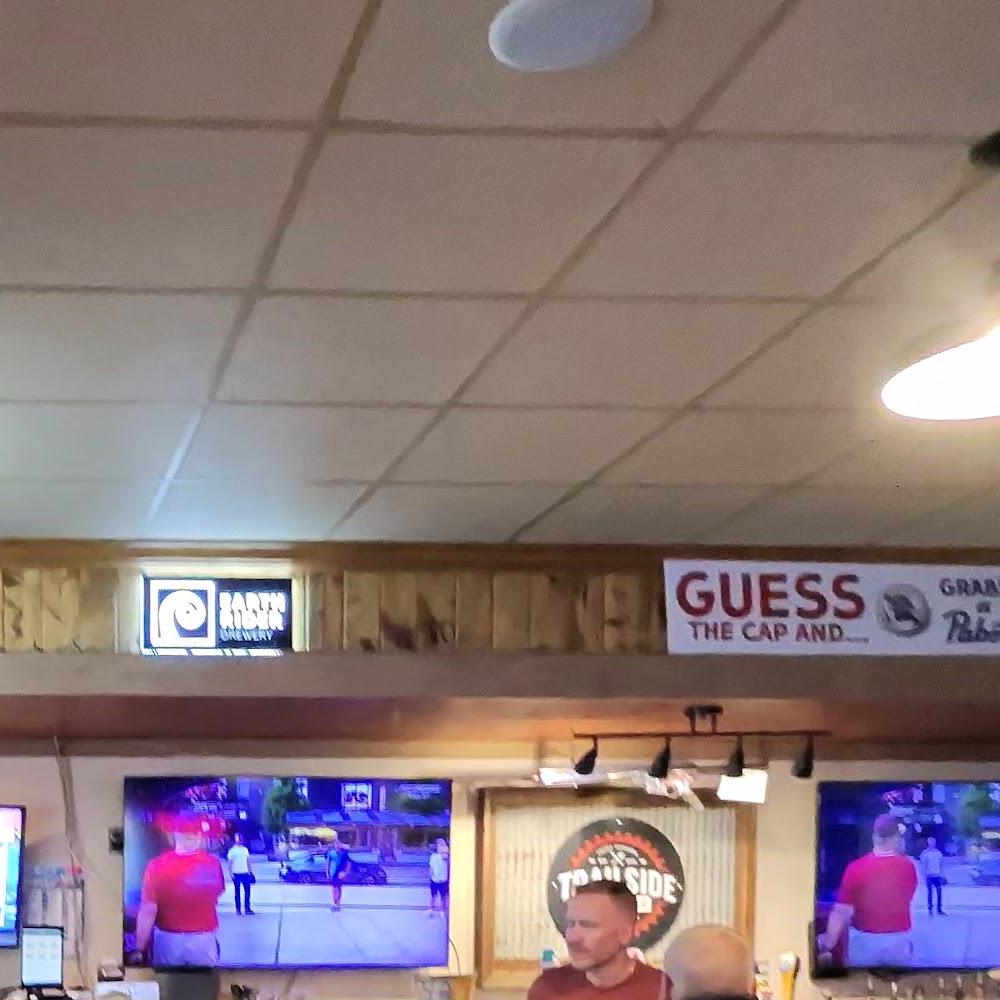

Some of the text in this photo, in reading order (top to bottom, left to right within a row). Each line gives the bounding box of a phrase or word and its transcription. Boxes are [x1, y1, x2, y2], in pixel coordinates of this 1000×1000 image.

[676, 571, 866, 620] GUESS
[688, 621, 733, 641] THE
[741, 622, 789, 642] CAP
